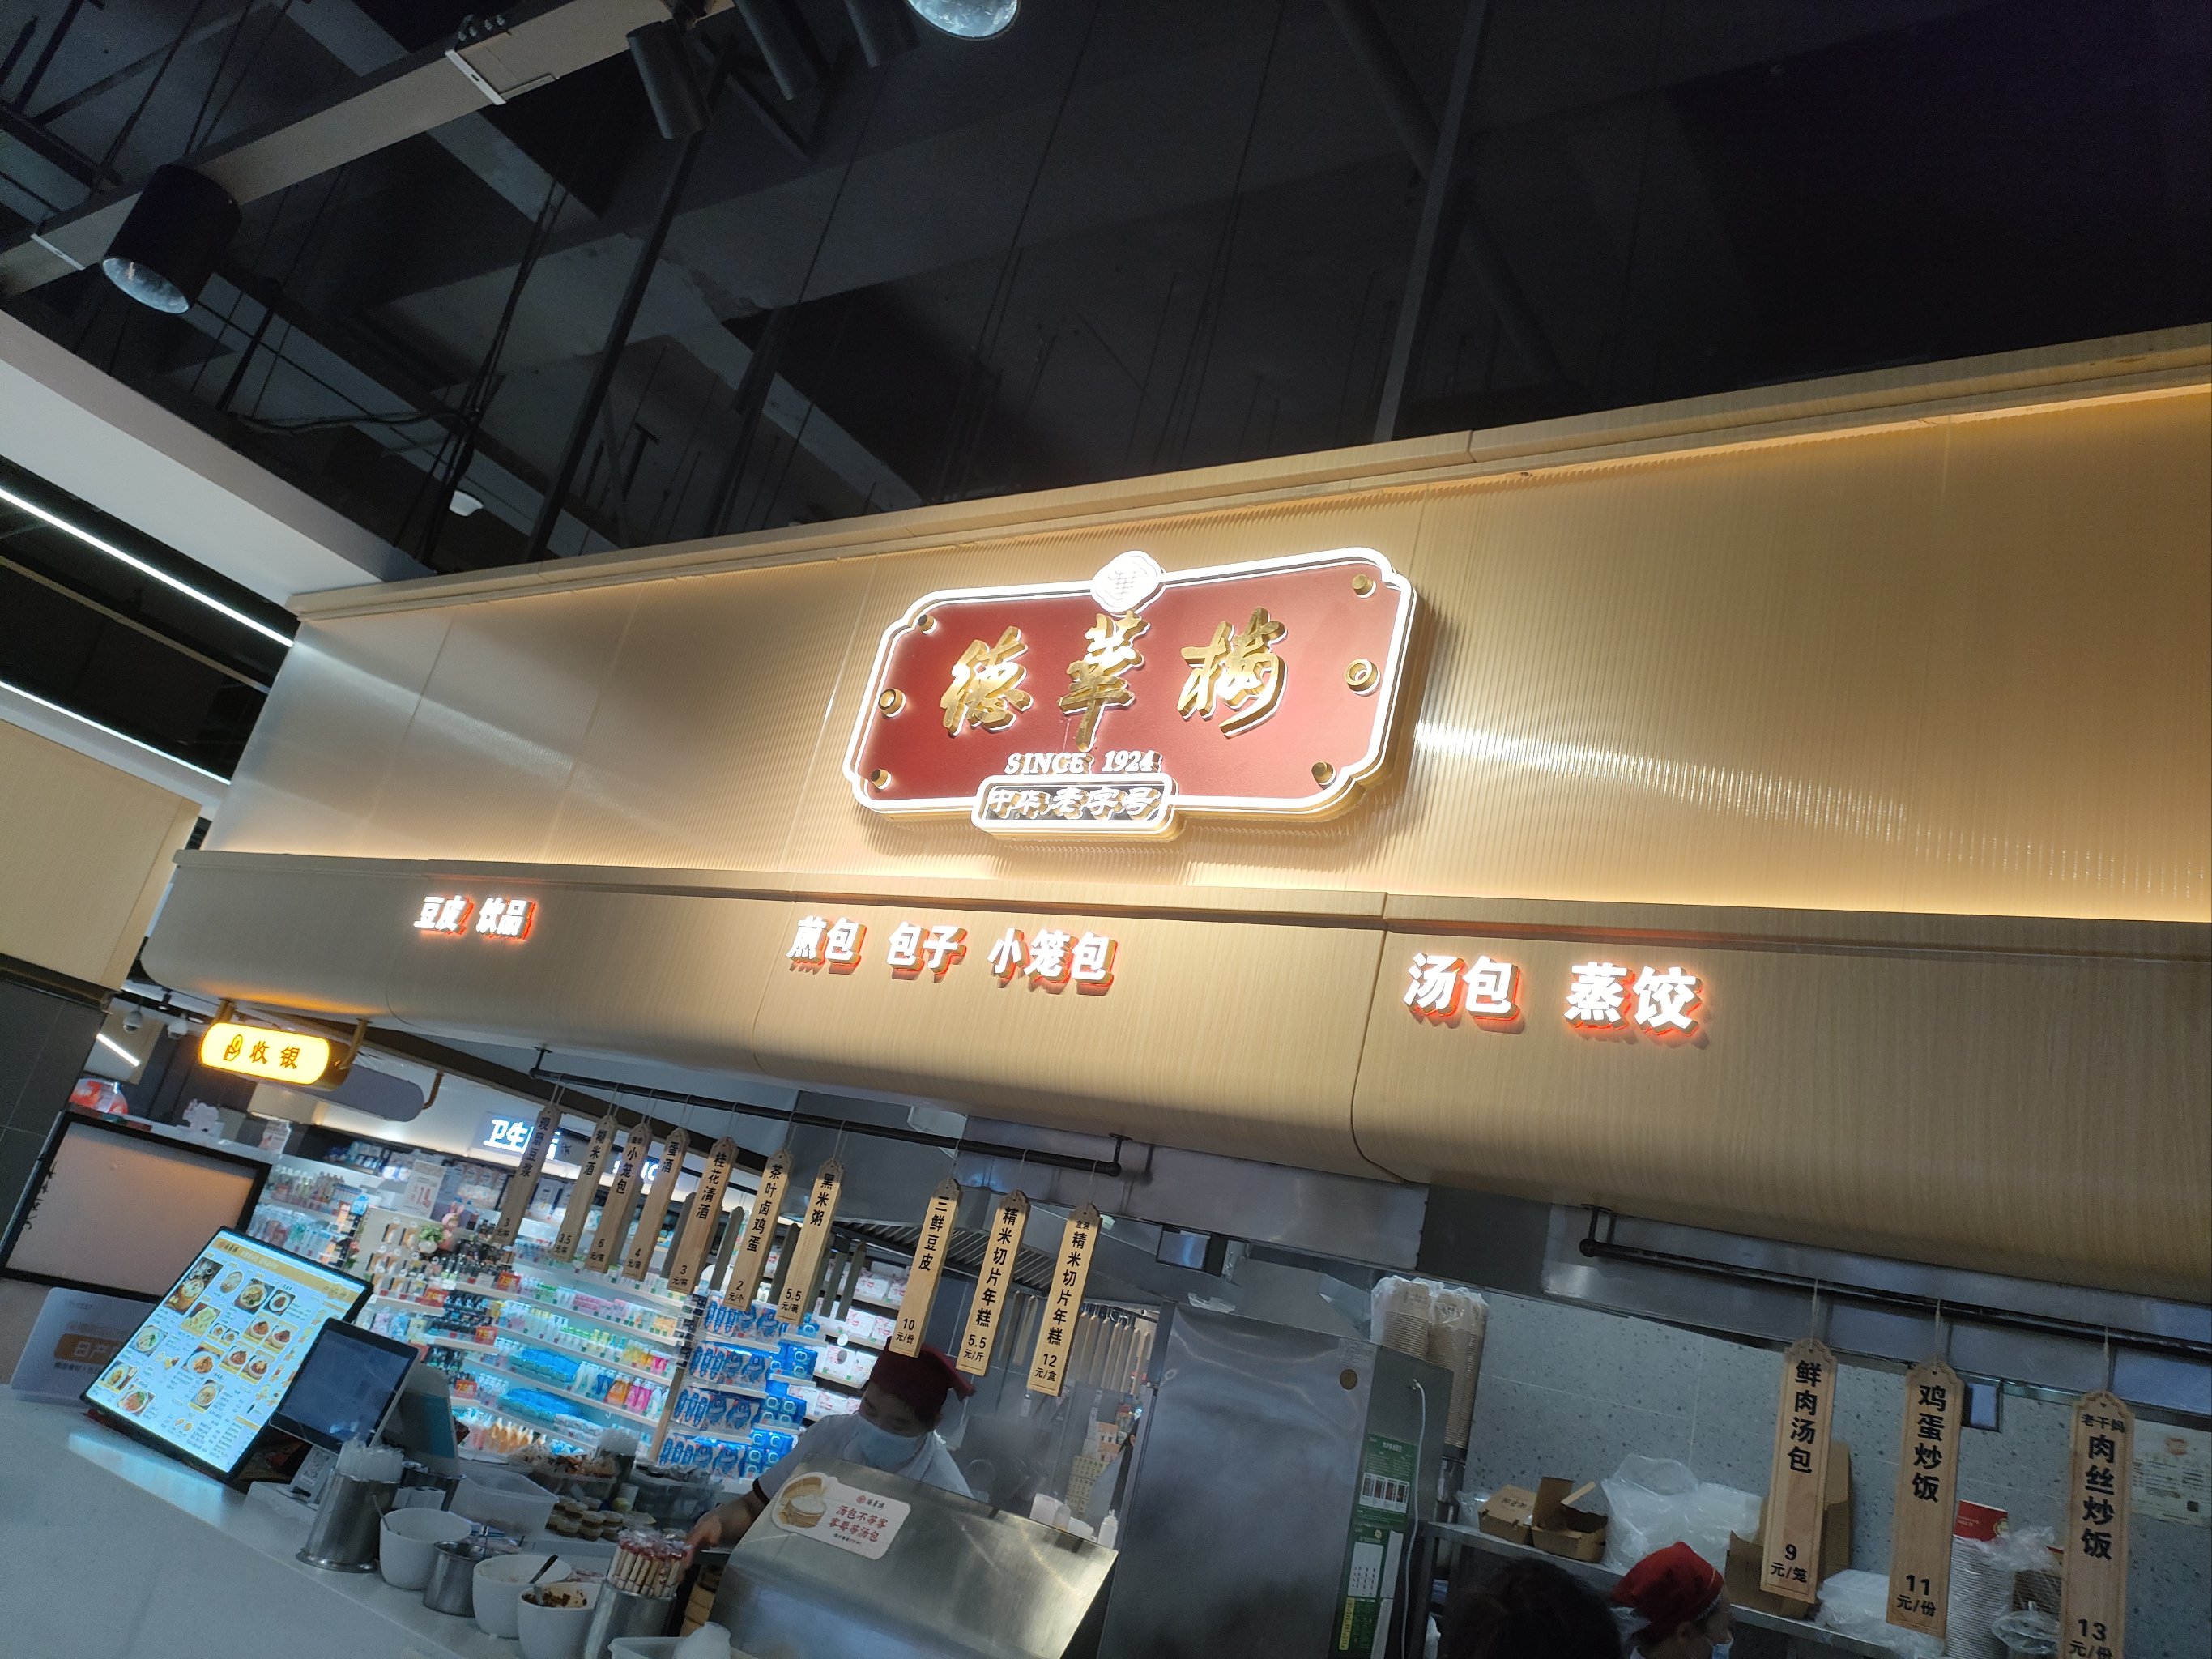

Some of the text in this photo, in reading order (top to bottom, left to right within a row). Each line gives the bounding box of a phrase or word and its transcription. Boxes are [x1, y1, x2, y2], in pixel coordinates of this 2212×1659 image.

[1004, 750, 1161, 775] SINCE 1924
[989, 786, 1161, 819] 中华老字号
[414, 895, 530, 937] 豆皮 饮品
[786, 916, 1112, 983] 煎包 包子 小笼包
[1404, 952, 1698, 1031] 汤包 蒸饺
[249, 1041, 300, 1069] 收银
[661, 1141, 684, 1174] 蛋酒
[616, 1146, 637, 1195] 小笼包
[696, 1152, 727, 1220] 桂花清酒
[747, 1164, 784, 1252] 茶叶卤鸡蛋
[810, 1173, 835, 1226] 黑米粥
[504, 1218, 511, 1227] 3
[918, 1196, 949, 1272] 三鲜豆皮
[559, 1233, 572, 1245] 3.5
[598, 1238, 606, 1248] 6
[634, 1248, 641, 1258] 4
[680, 1265, 688, 1275] 3
[975, 1207, 1016, 1328] 精米切片年糕
[728, 1292, 744, 1303] 元/个
[735, 1280, 744, 1291] 2
[785, 1289, 803, 1301] 5.5
[1047, 1231, 1087, 1346] 精米切片年糕
[903, 1318, 915, 1331] 10
[896, 1331, 914, 1345] 元/份
[968, 1334, 987, 1349] 5.5
[963, 1349, 984, 1362] 元/斤
[1042, 1354, 1057, 1367] 12
[1034, 1367, 1057, 1382] 元/盒
[1788, 1359, 1822, 1474] 鲜肉汤包
[2081, 1414, 2126, 1433] 老干妈
[1912, 1384, 1947, 1503] 鸡蛋炒饭
[2081, 1434, 2116, 1560] 肉丝炒饭
[1784, 1543, 1797, 1561] 9
[1770, 1562, 1808, 1583] 元/笼
[1906, 1574, 1930, 1596] 11
[1896, 1593, 1937, 1618] 元/份
[2078, 1618, 2106, 1642] 13
